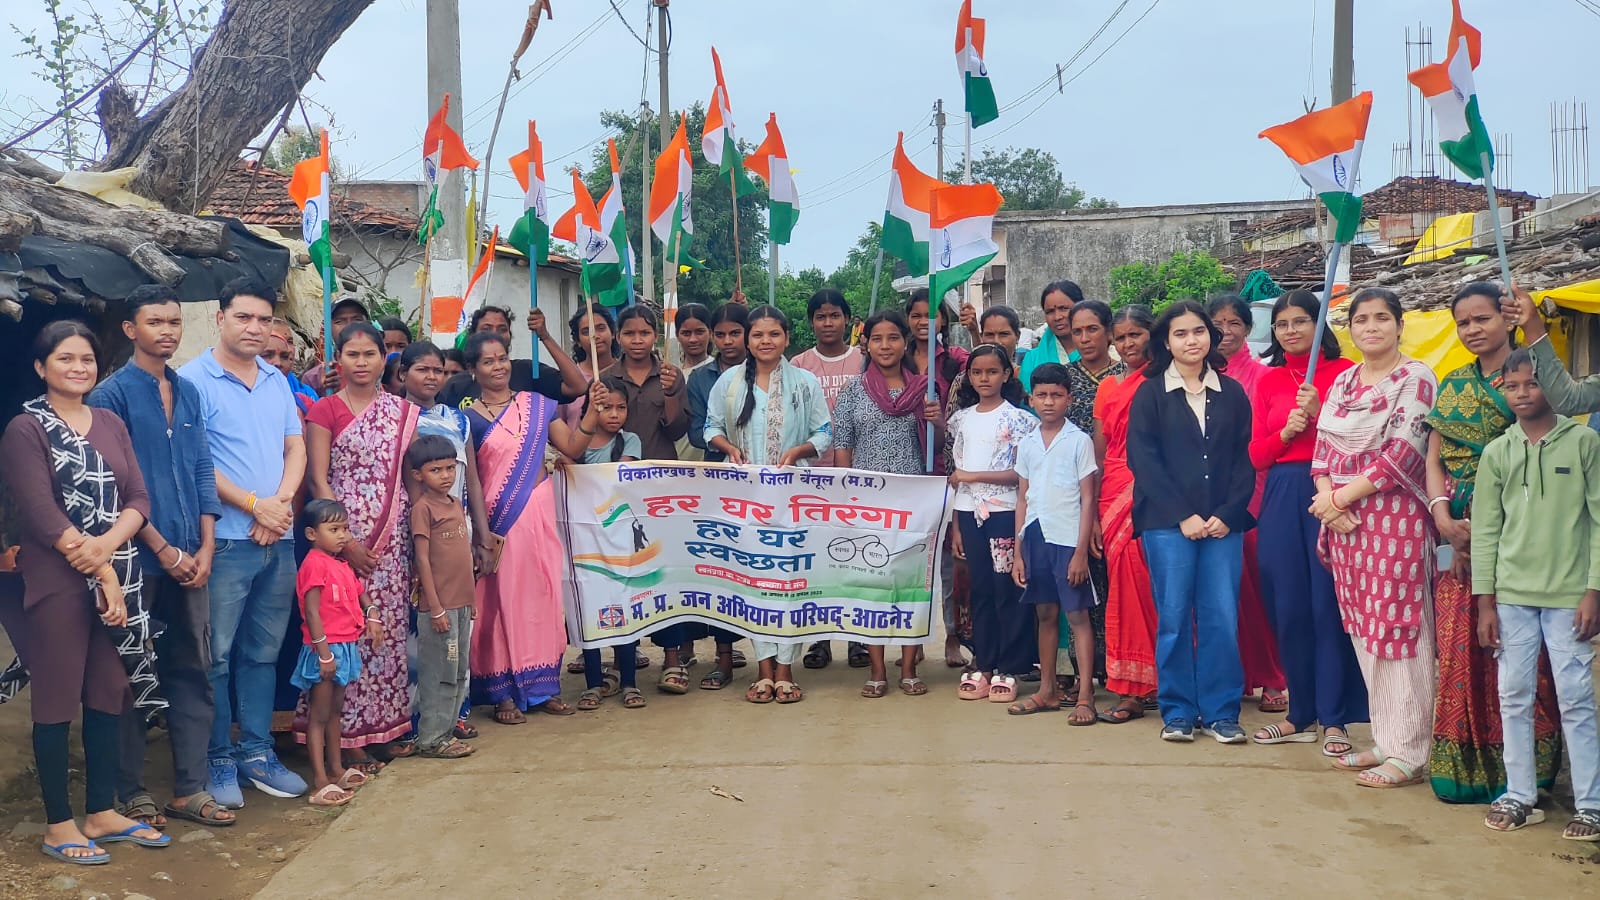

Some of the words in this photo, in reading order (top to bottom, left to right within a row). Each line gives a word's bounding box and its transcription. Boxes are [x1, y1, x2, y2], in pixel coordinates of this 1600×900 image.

[617, 464, 696, 482] विकासखण्ड
[759, 468, 794, 486] जिला
[643, 495, 701, 518] हर
[719, 497, 775, 525] घर
[788, 494, 912, 530] तिरंगा
[693, 519, 742, 543] हर
[757, 529, 809, 548] घर
[684, 541, 816, 573] स्वच्छता
[630, 602, 649, 621] म.
[653, 593, 673, 614] प्र.
[680, 590, 712, 610] जन
[717, 594, 785, 629] अभियान
